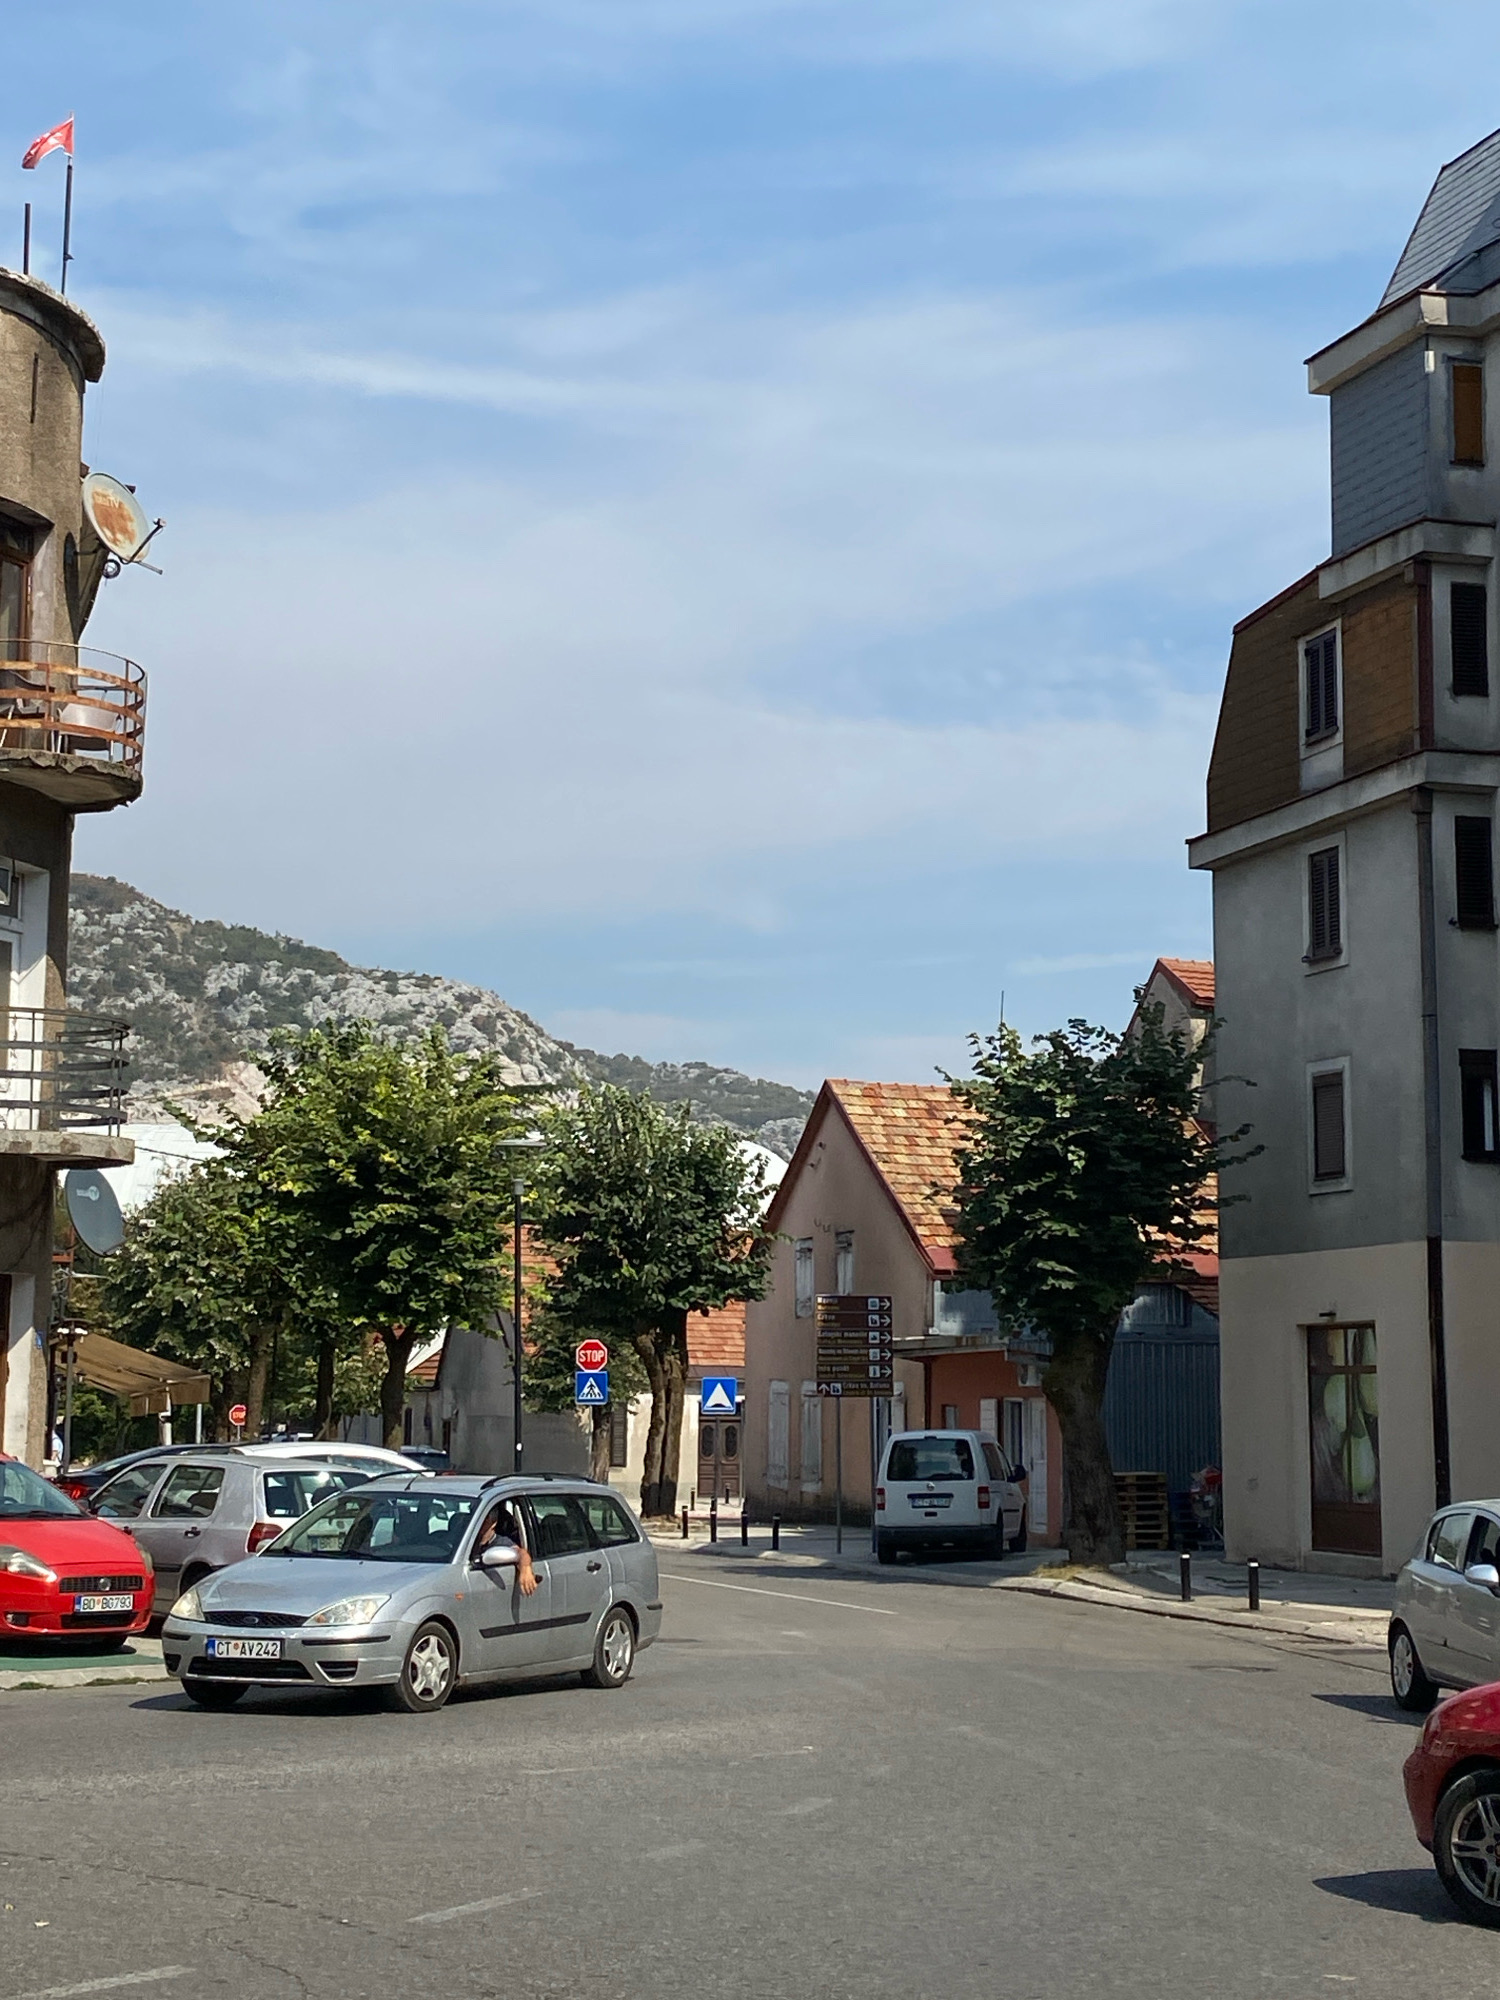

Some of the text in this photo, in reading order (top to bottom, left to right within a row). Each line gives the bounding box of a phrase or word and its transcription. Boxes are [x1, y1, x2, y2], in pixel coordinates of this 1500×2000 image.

[579, 1350, 604, 1362] STOP
[217, 1641, 279, 1657] CT AV242
